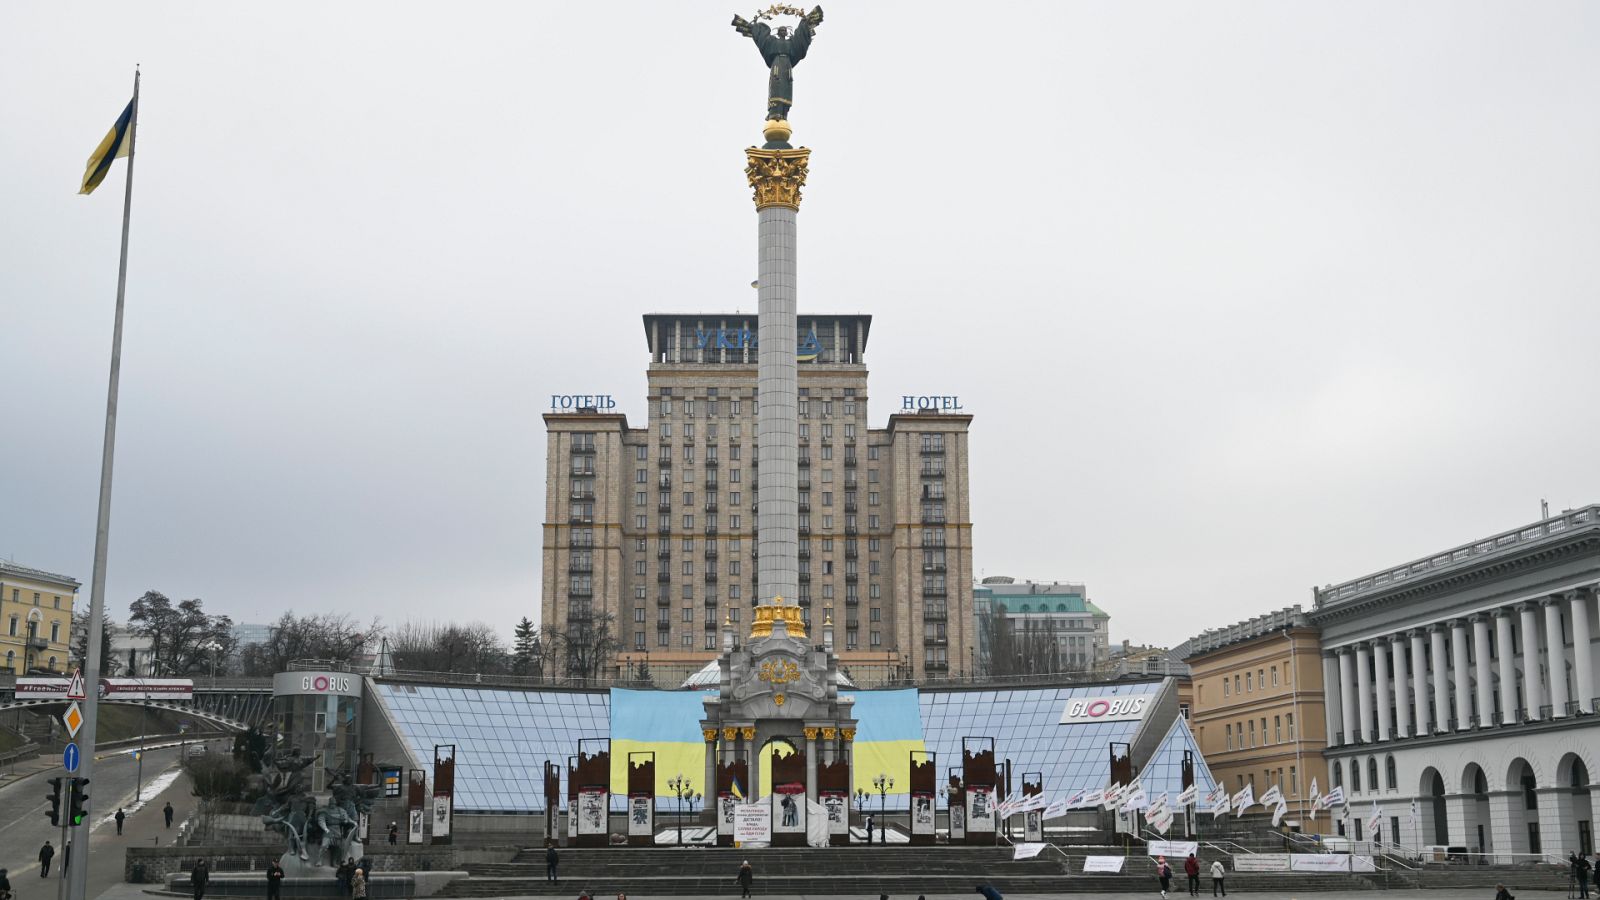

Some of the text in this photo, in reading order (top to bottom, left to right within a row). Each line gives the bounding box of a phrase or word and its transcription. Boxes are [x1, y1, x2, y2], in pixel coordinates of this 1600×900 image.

[696, 328, 820, 350] УКРА
[551, 395, 616, 408] ГОТЕЛЬ
[902, 396, 963, 409] HOTEL
[302, 676, 349, 692] GLOBUS
[1069, 697, 1145, 717] GLOBUS
